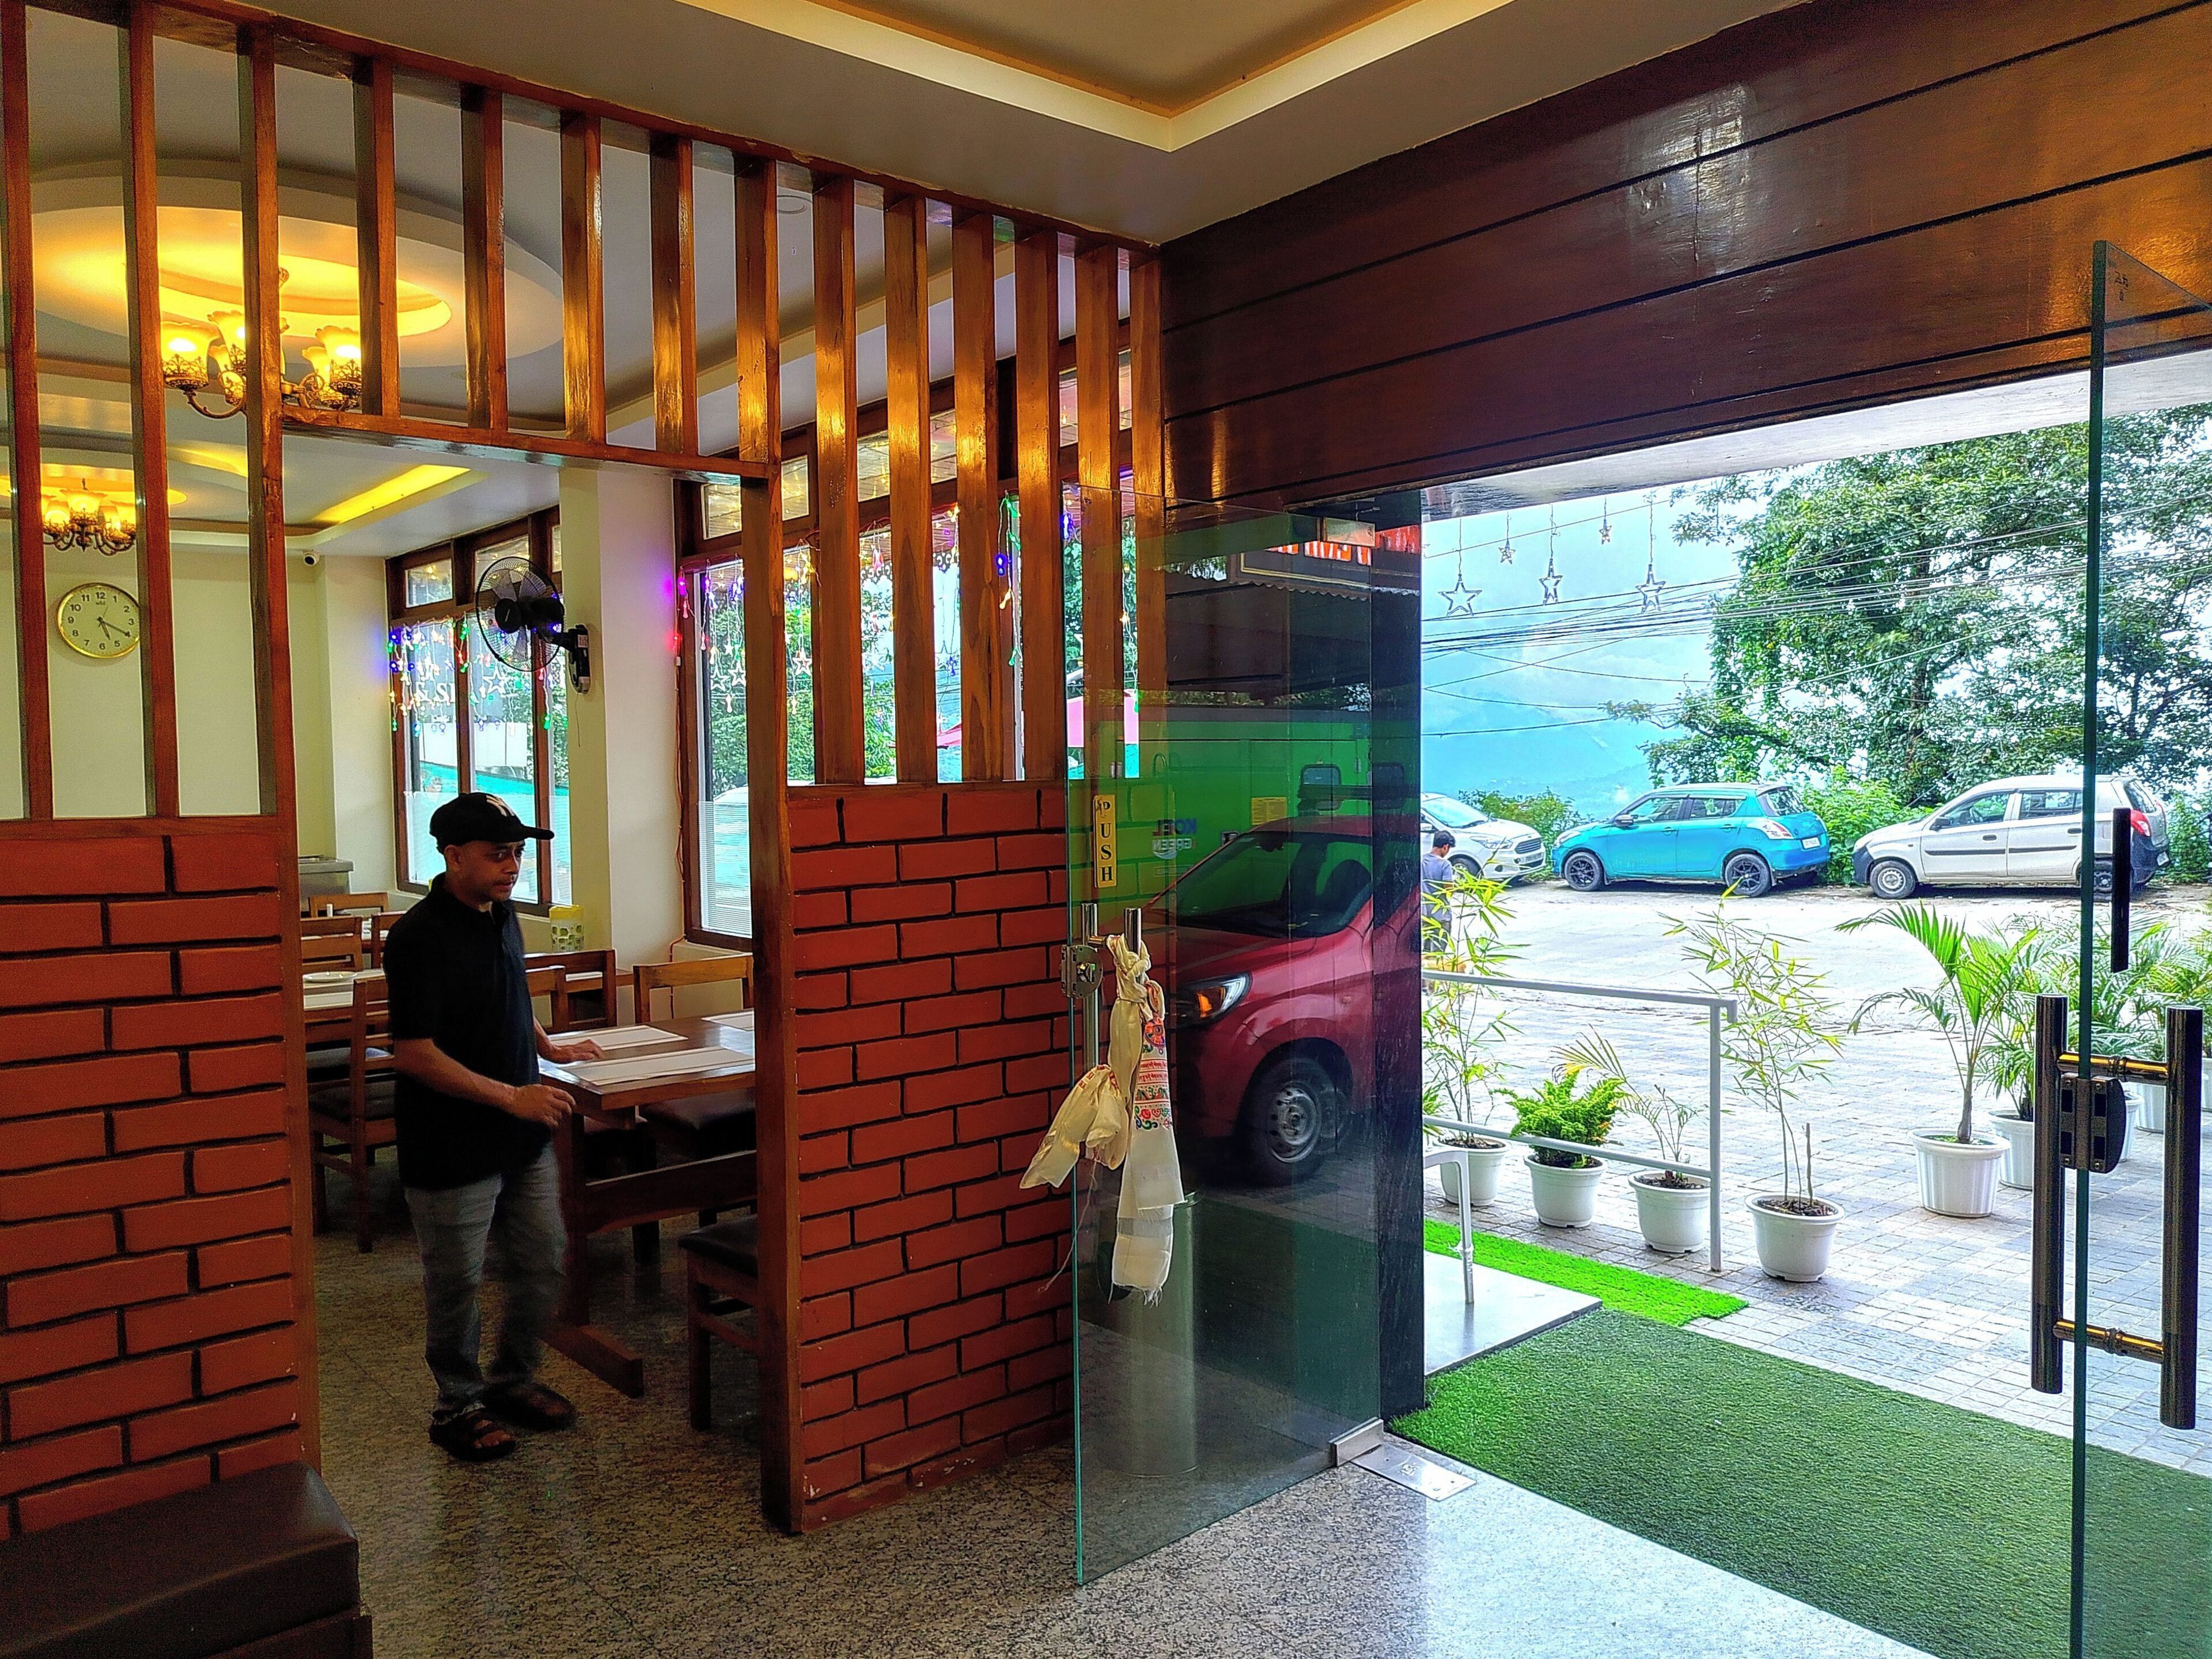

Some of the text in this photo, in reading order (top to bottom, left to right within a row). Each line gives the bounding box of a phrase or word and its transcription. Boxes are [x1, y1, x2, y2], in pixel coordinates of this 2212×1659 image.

[81, 594, 90, 602] 11
[70, 604, 81, 612] 10
[1098, 800, 1113, 882] PUSH
